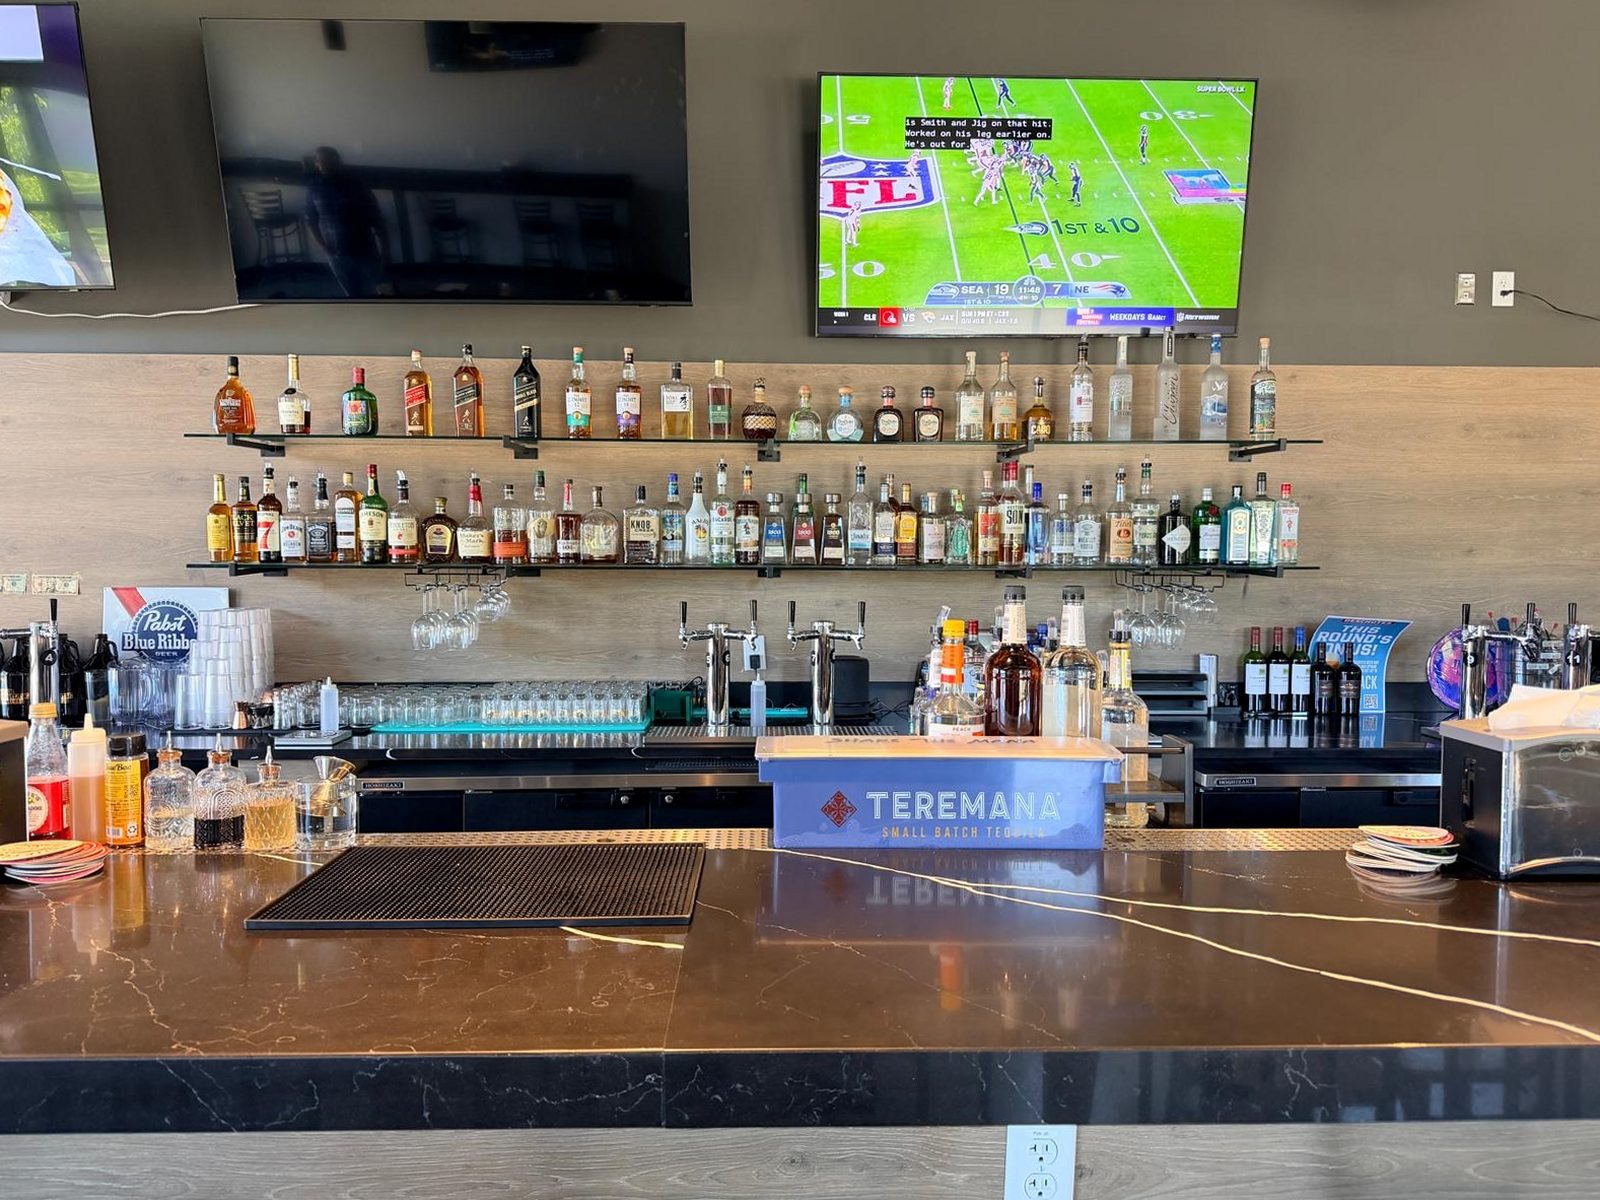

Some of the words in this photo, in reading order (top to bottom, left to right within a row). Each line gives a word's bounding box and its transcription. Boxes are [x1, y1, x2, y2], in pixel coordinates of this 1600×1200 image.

[905, 119, 917, 127] is
[920, 118, 947, 127] Smith
[951, 119, 967, 127] and
[971, 119, 987, 129] Jig
[1006, 119, 1028, 128] that
[1032, 120, 1052, 128] hit.
[904, 129, 936, 138] Worked
[955, 130, 972, 138] his
[976, 130, 992, 139] leg
[995, 130, 1033, 139] earlier
[904, 140, 926, 149] He's
[929, 141, 947, 149] out
[950, 140, 971, 149] for.
[1051, 218, 1088, 235] 1ST
[1094, 222, 1109, 234] &
[1107, 216, 1140, 234] 10
[961, 286, 984, 295] SEA
[994, 283, 1010, 295] 19
[1053, 283, 1063, 295] 7
[1074, 286, 1090, 294] NE
[863, 313, 877, 321] CLE
[902, 313, 916, 323] VS
[940, 313, 955, 321] JAX
[1109, 312, 1146, 322] WEEKDAYS
[1006, 509, 1024, 525] SON
[630, 520, 651, 530] KNOB
[257, 521, 275, 550] 7
[143, 610, 188, 632] Pabst
[1341, 624, 1382, 635] THIS
[123, 633, 156, 650] Blue
[157, 633, 197, 650] Ribb
[1316, 630, 1394, 645] ROUND'S
[1325, 642, 1379, 657] ONUS!
[44, 653, 54, 663] 4
[1466, 654, 1475, 664] 9
[1566, 655, 1581, 664] 11
[865, 790, 1062, 821] TEREMANA
[882, 826, 927, 839] SMALL
[934, 826, 978, 839] BATCH
[986, 826, 1047, 839] TEQUILA
